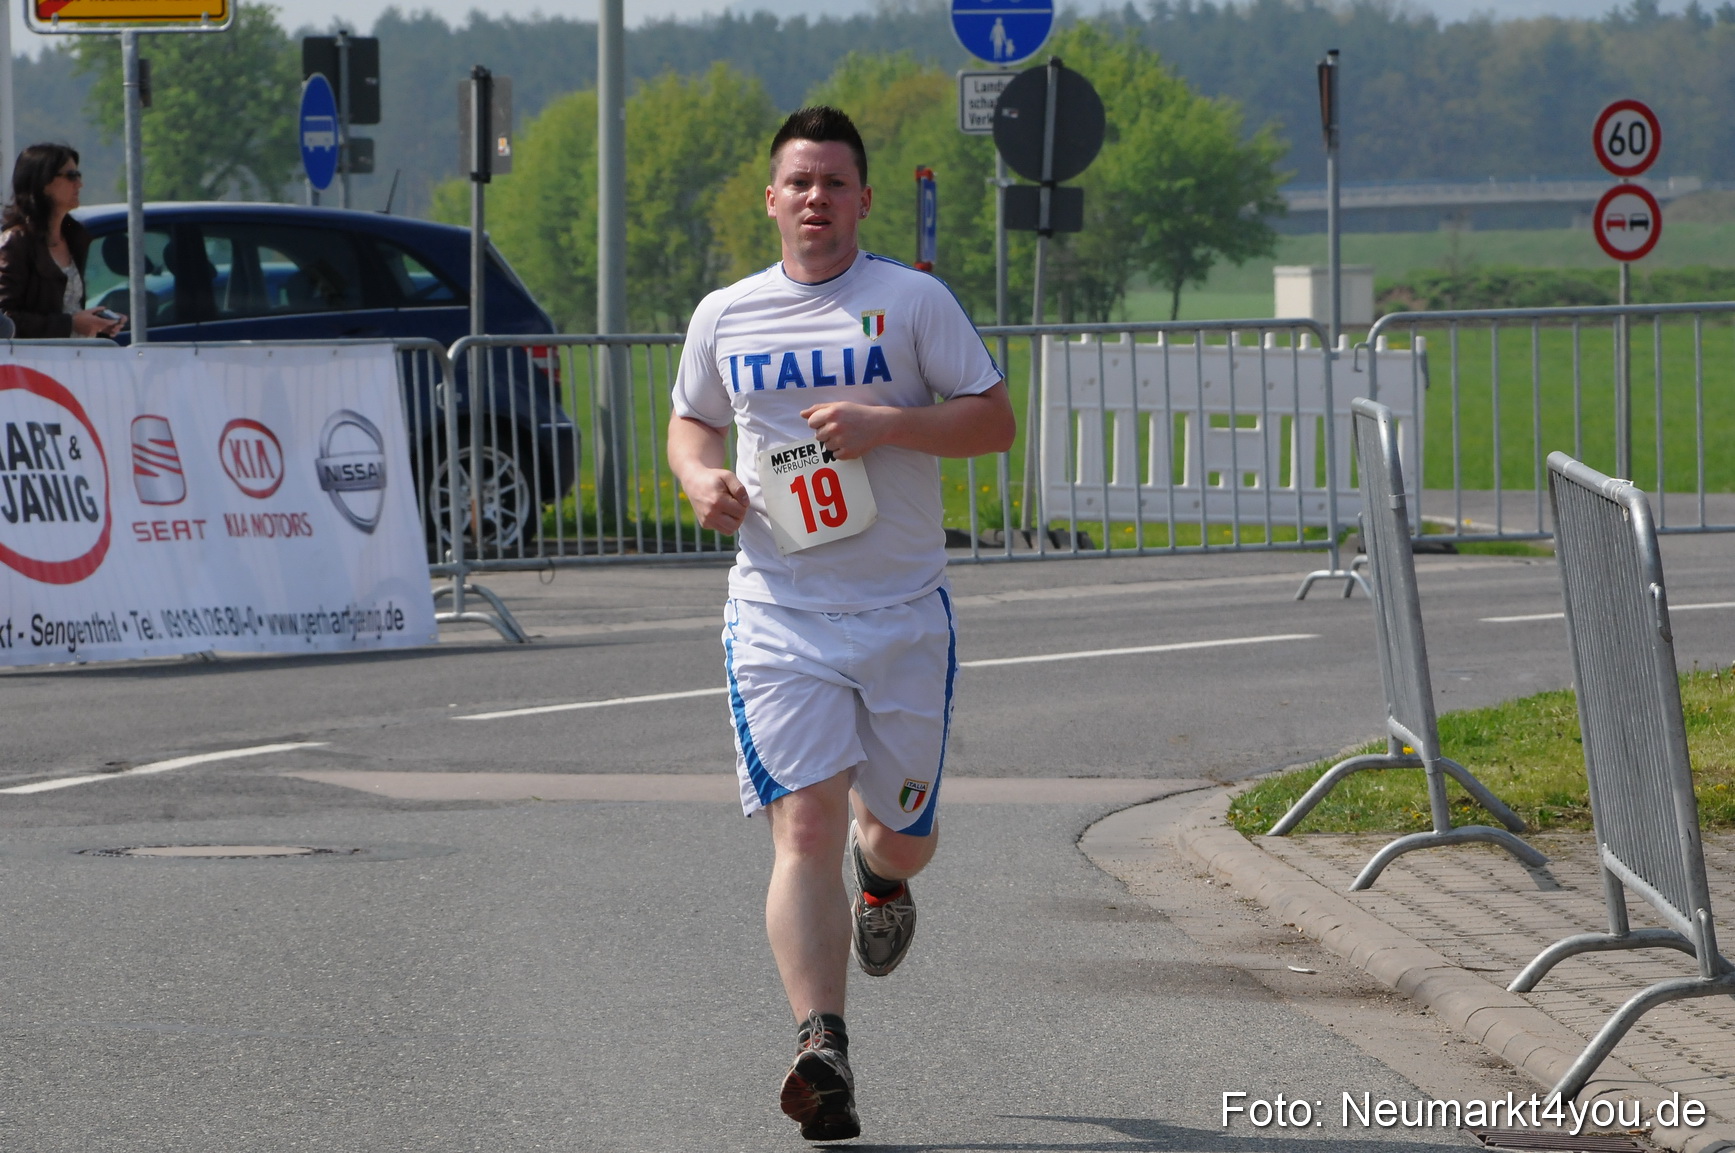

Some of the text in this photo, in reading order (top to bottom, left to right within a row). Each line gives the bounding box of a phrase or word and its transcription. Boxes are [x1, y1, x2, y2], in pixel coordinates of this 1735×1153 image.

[1608, 121, 1646, 156] 60
[729, 345, 893, 393] ITALIA
[68, 435, 82, 461] &
[229, 439, 276, 479] KIA
[770, 443, 817, 467] MEYER
[773, 455, 820, 476] WERBUNG
[1, 473, 100, 524] JÄNIG
[790, 467, 849, 535] 19
[133, 518, 207, 542] SEAT
[223, 512, 313, 539] KIA MOTORS
[906, 781, 926, 790] ITALIA
